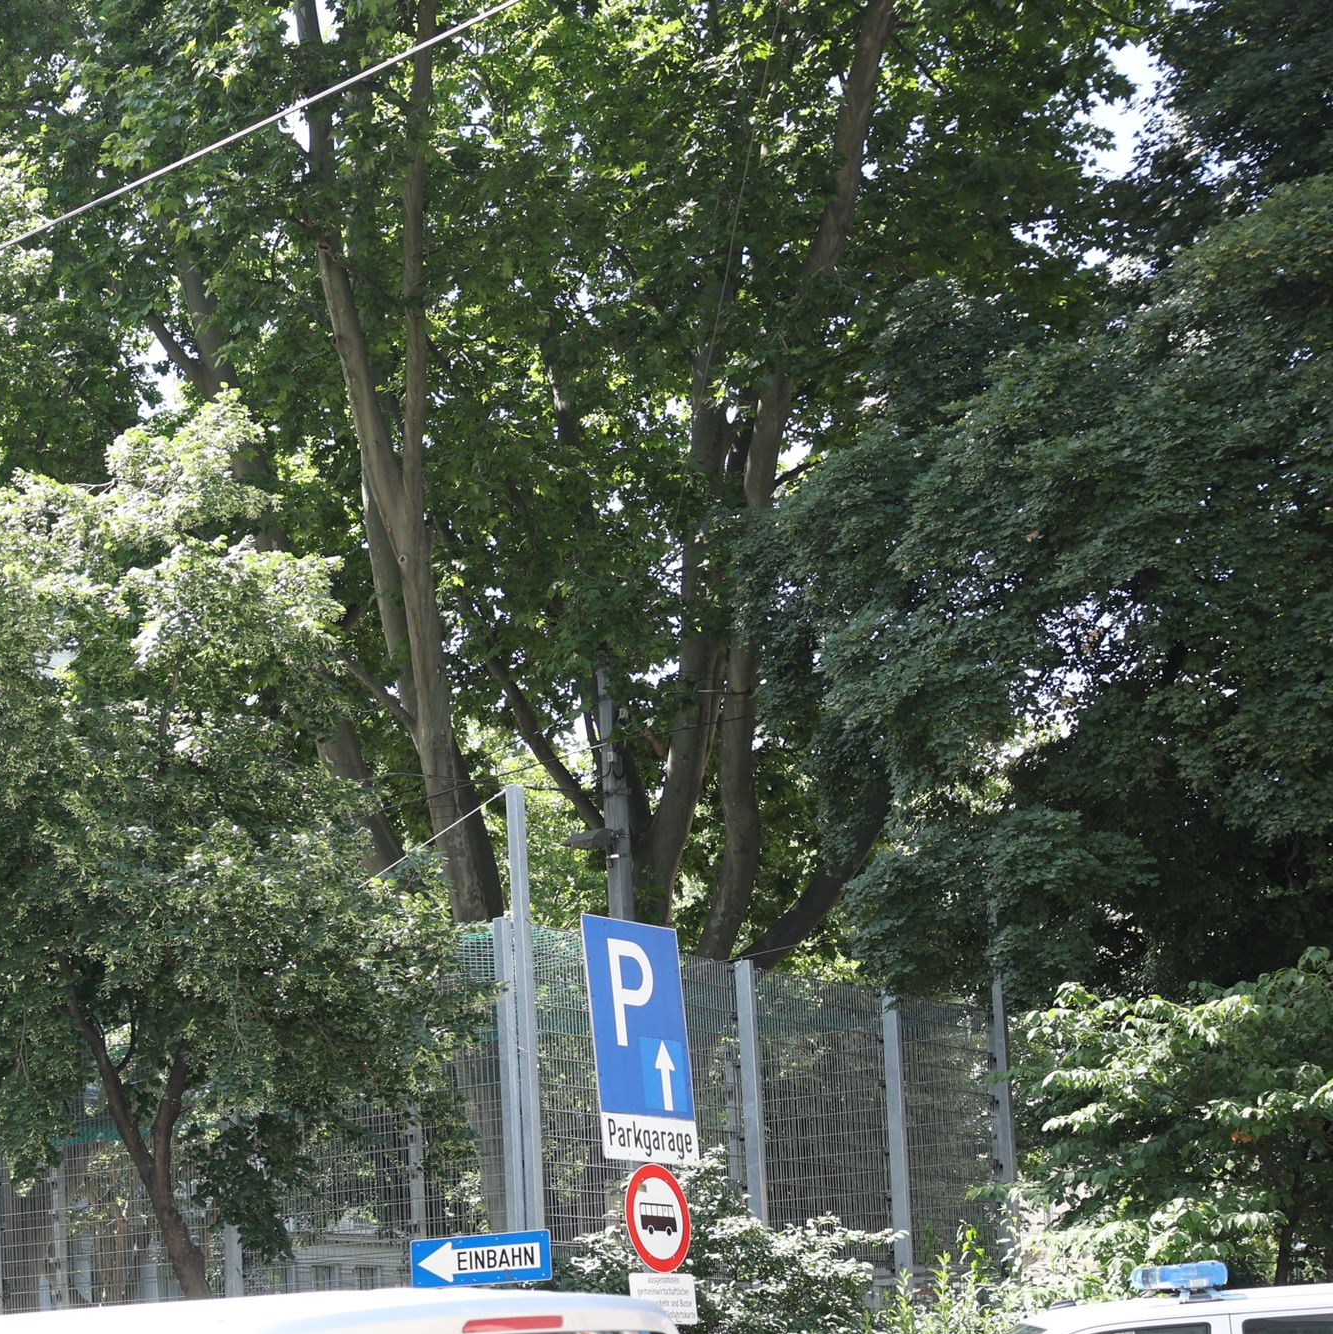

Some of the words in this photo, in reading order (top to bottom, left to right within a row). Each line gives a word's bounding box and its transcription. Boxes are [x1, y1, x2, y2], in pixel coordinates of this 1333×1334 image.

[606, 937, 654, 1047] P
[608, 1117, 693, 1160] Parkgarage
[457, 1245, 535, 1271] EINBAHN
